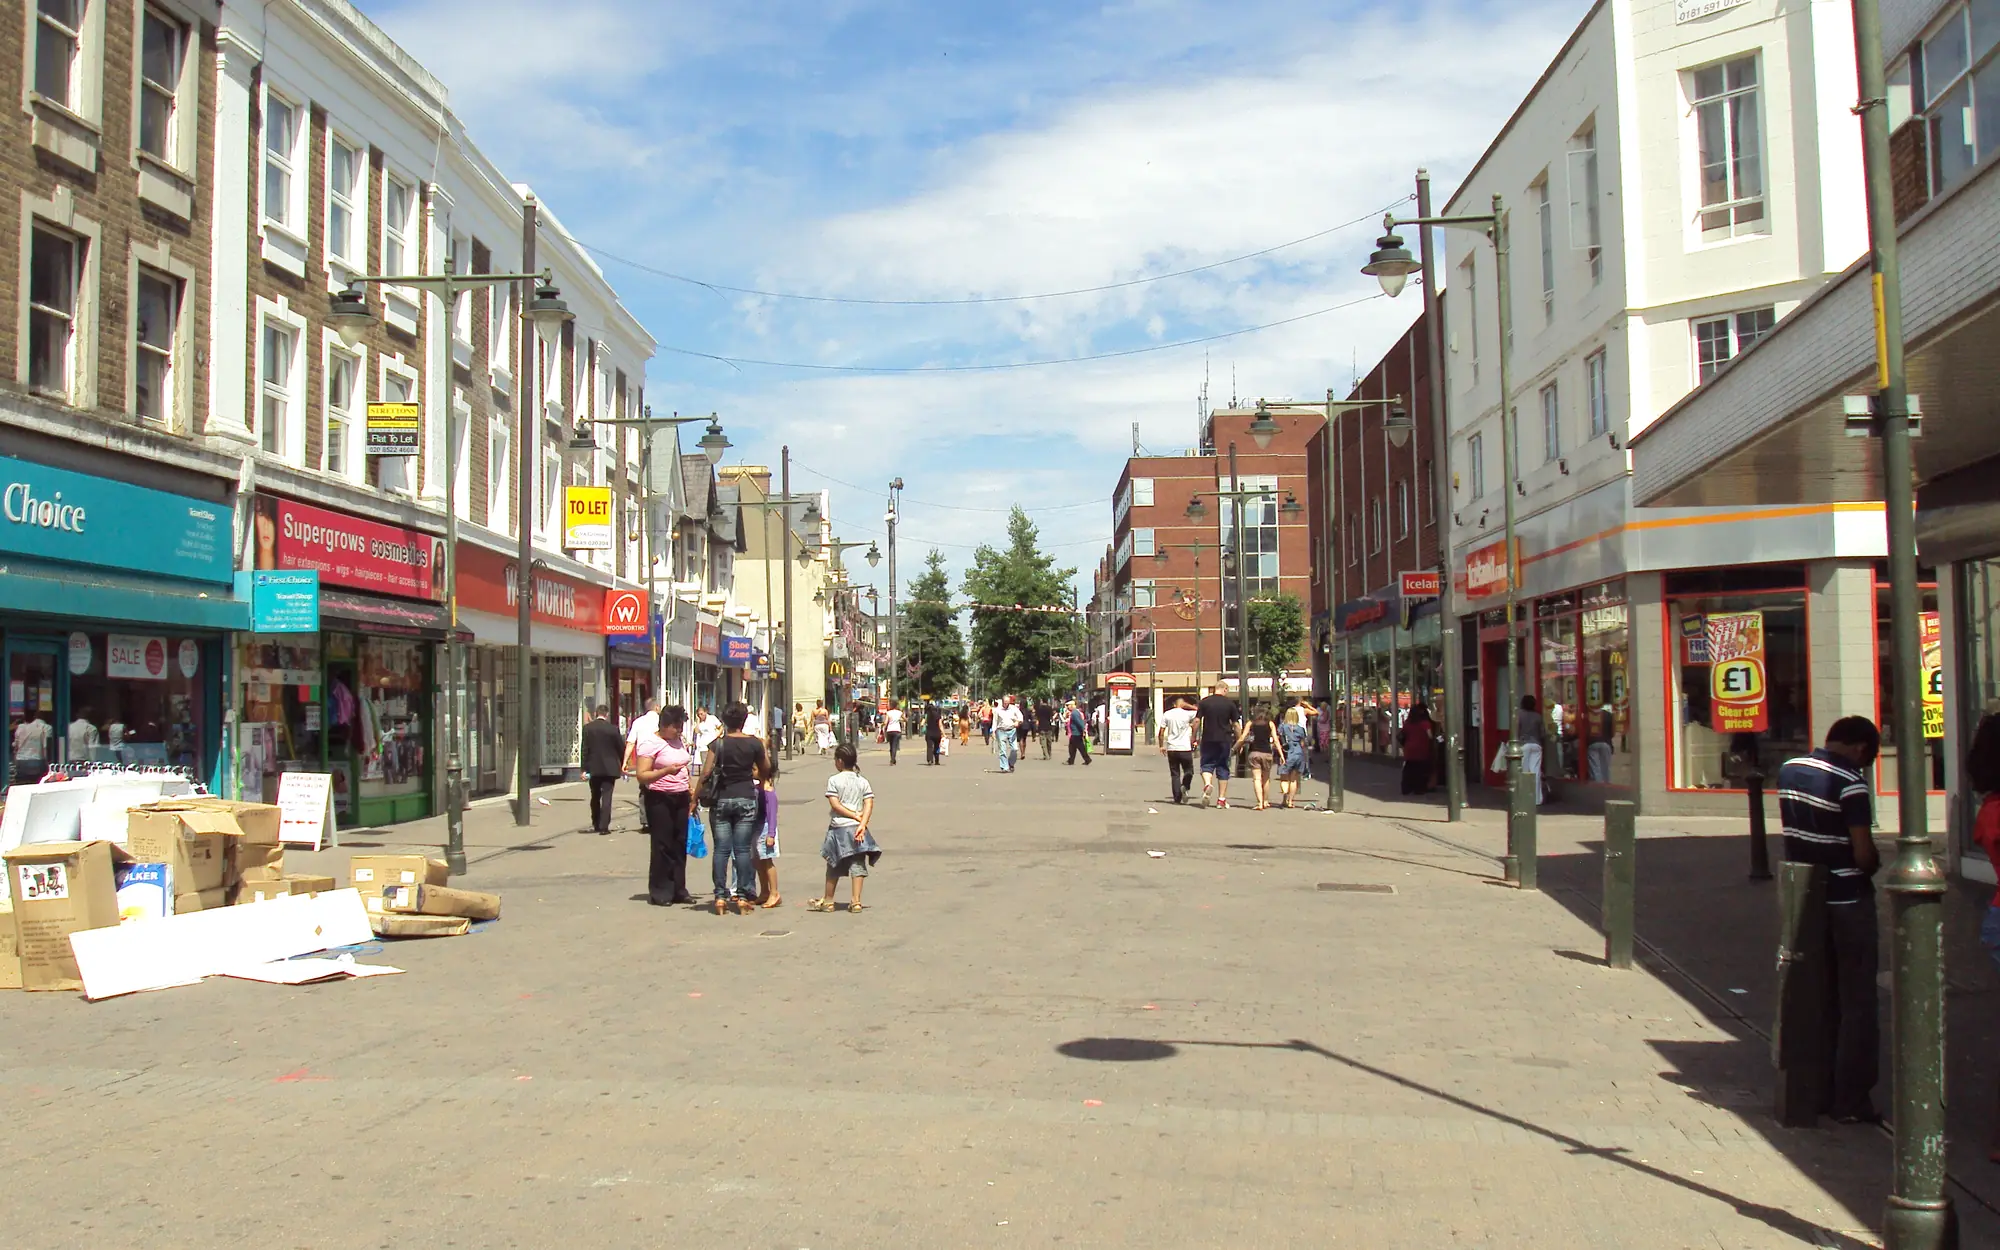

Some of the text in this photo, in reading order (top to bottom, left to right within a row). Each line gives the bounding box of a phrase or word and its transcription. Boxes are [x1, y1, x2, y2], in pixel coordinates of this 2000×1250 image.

[1679, 7, 1701, 21] 0181
[1703, 0, 1720, 13] 591
[371, 434, 414, 443] Flat To Let
[4, 482, 87, 533] Choice
[569, 500, 608, 515] TO LET
[283, 512, 428, 569] Supergrows cosmetics
[282, 553, 297, 565] hair
[297, 557, 331, 573] extensions
[336, 563, 350, 578] wigs
[355, 565, 383, 582] hairpieces
[387, 573, 399, 584] hair
[1405, 579, 1440, 590] Icelan
[606, 624, 646, 632] WOOLWORTHS
[728, 640, 750, 650] Shoe
[1690, 640, 1709, 651] FRE
[111, 647, 141, 666] SALE
[728, 650, 750, 658] Zone
[1722, 667, 1752, 692] £1
[1718, 705, 1759, 717] Clear cut
[1724, 719, 1753, 730] prices
